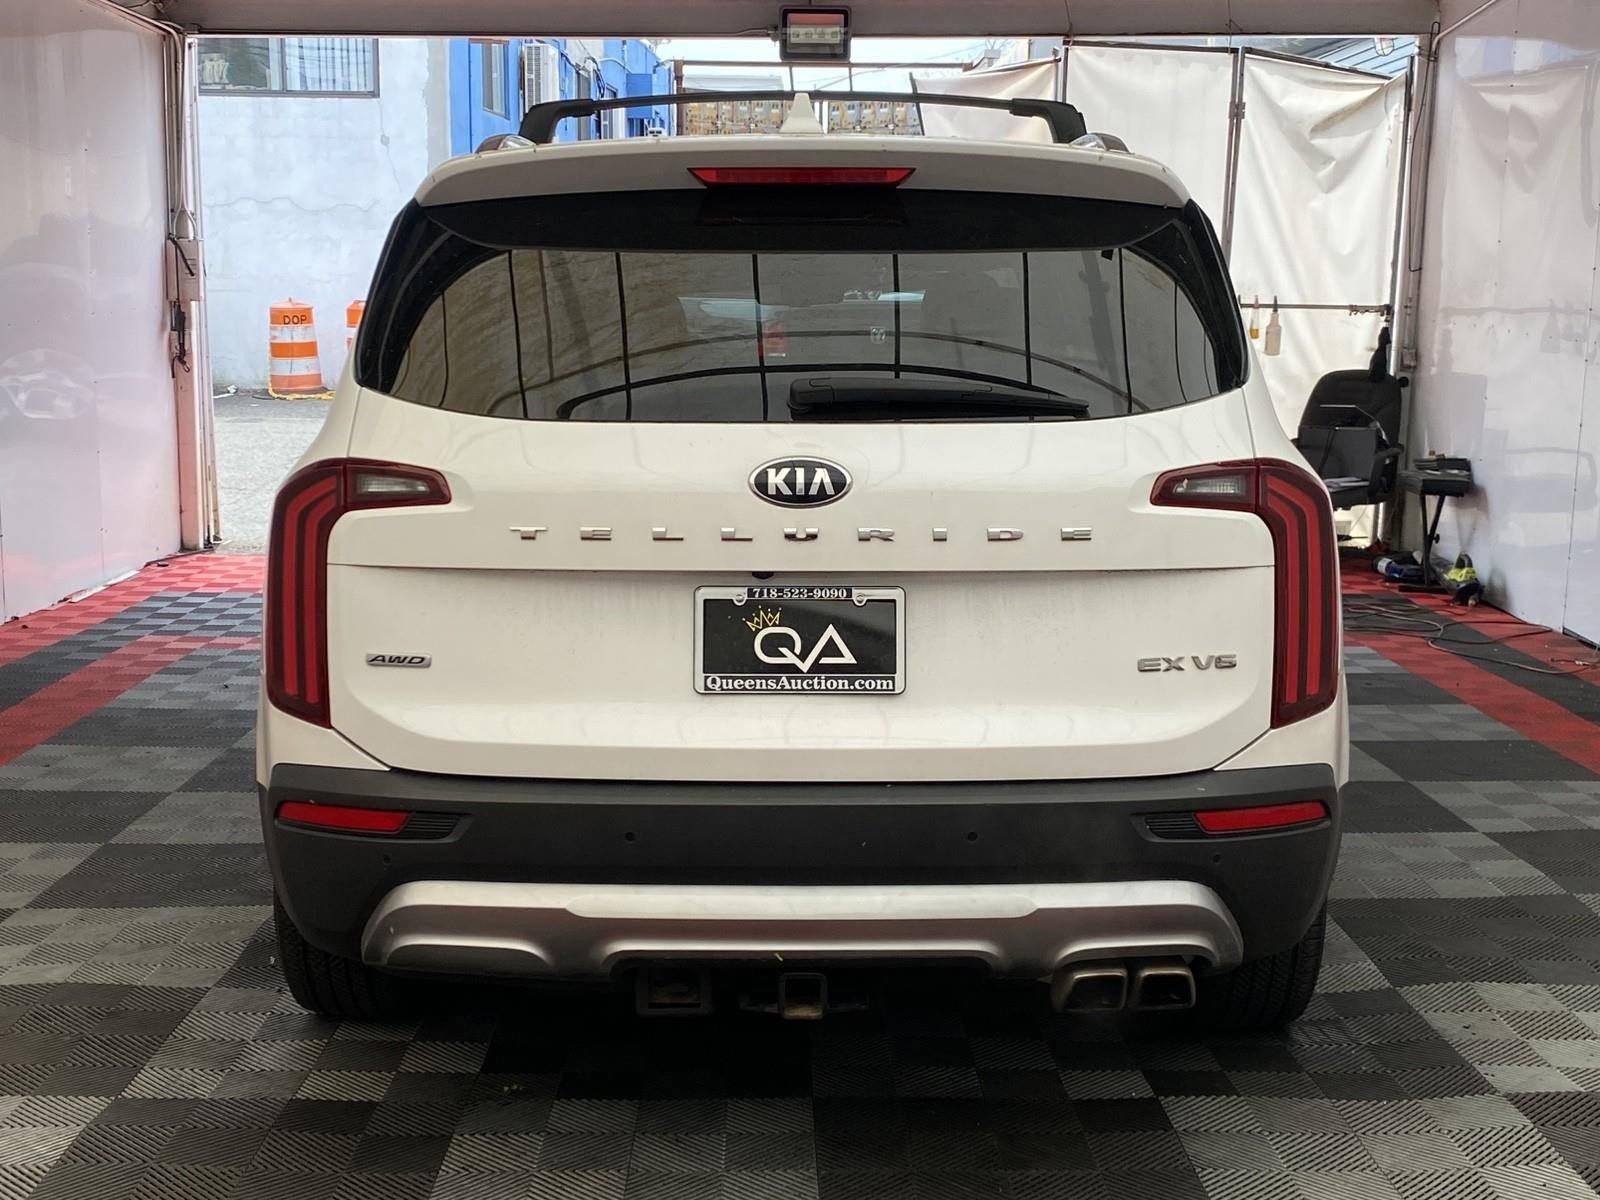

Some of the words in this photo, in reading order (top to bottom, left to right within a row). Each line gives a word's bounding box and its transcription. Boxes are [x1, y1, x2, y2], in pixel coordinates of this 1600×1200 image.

[283, 315, 307, 325] DOP
[766, 467, 836, 496] KIA
[509, 526, 1093, 542] TELLURIDE
[752, 587, 848, 600] 718-523-9090
[753, 623, 858, 674] QA
[368, 654, 426, 665] AWD
[1137, 656, 1185, 673] EX
[1190, 653, 1238, 671] V6
[705, 675, 895, 692] QueensAuction.com
